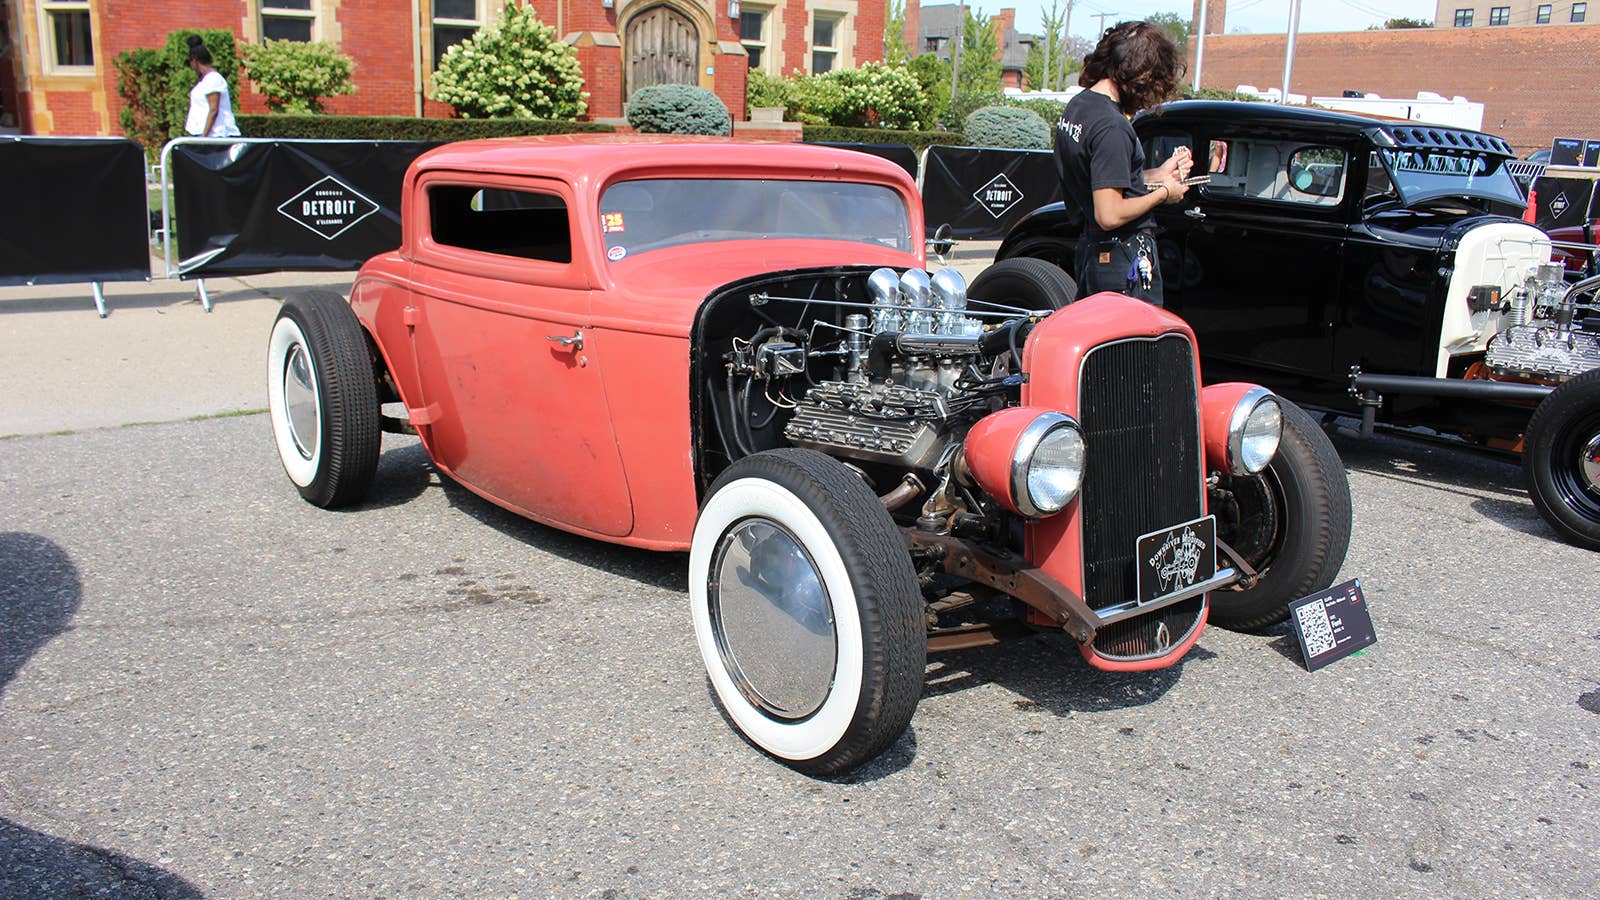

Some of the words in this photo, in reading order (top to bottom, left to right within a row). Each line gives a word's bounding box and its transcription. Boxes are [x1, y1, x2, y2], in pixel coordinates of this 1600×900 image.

[986, 190, 1013, 201] DETROIT
[302, 200, 356, 216] DETROIT
[606, 213, 623, 227] 25
